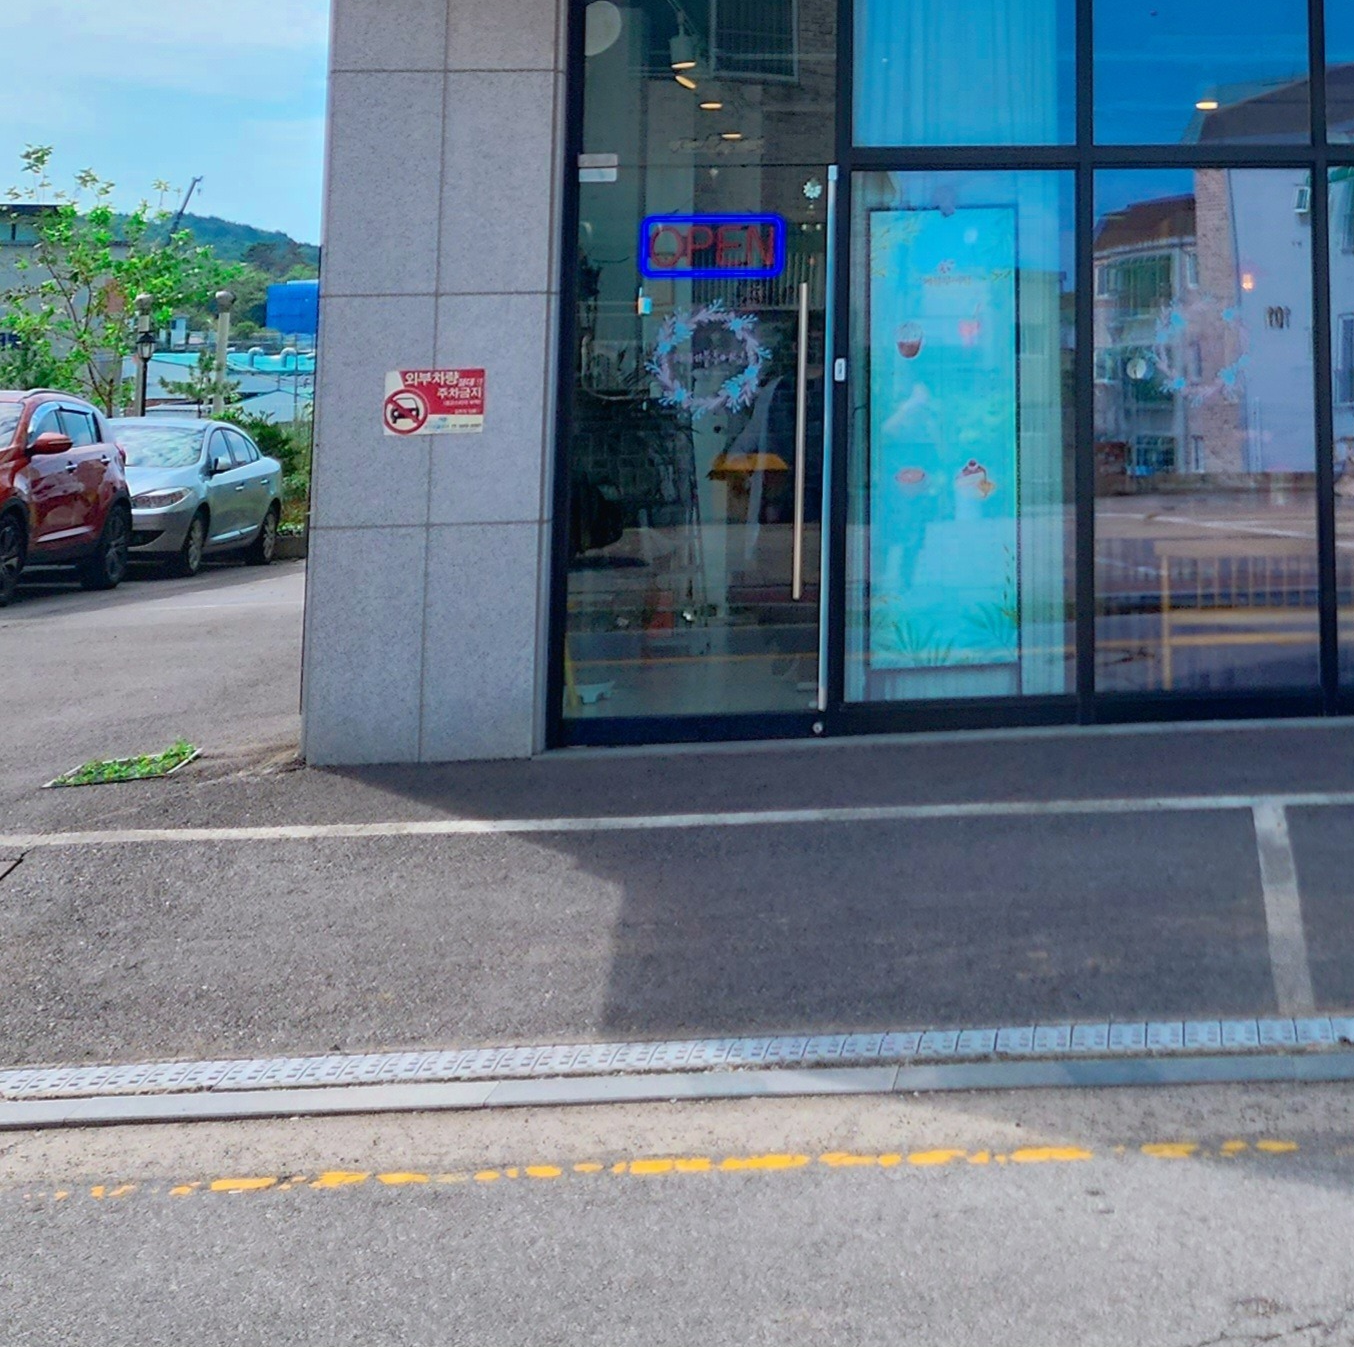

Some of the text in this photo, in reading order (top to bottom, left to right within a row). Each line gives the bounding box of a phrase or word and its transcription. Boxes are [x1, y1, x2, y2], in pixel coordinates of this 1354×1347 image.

[649, 225, 775, 268] OPEN
[405, 371, 459, 386] 외부차량
[437, 387, 482, 399] 주차금지
